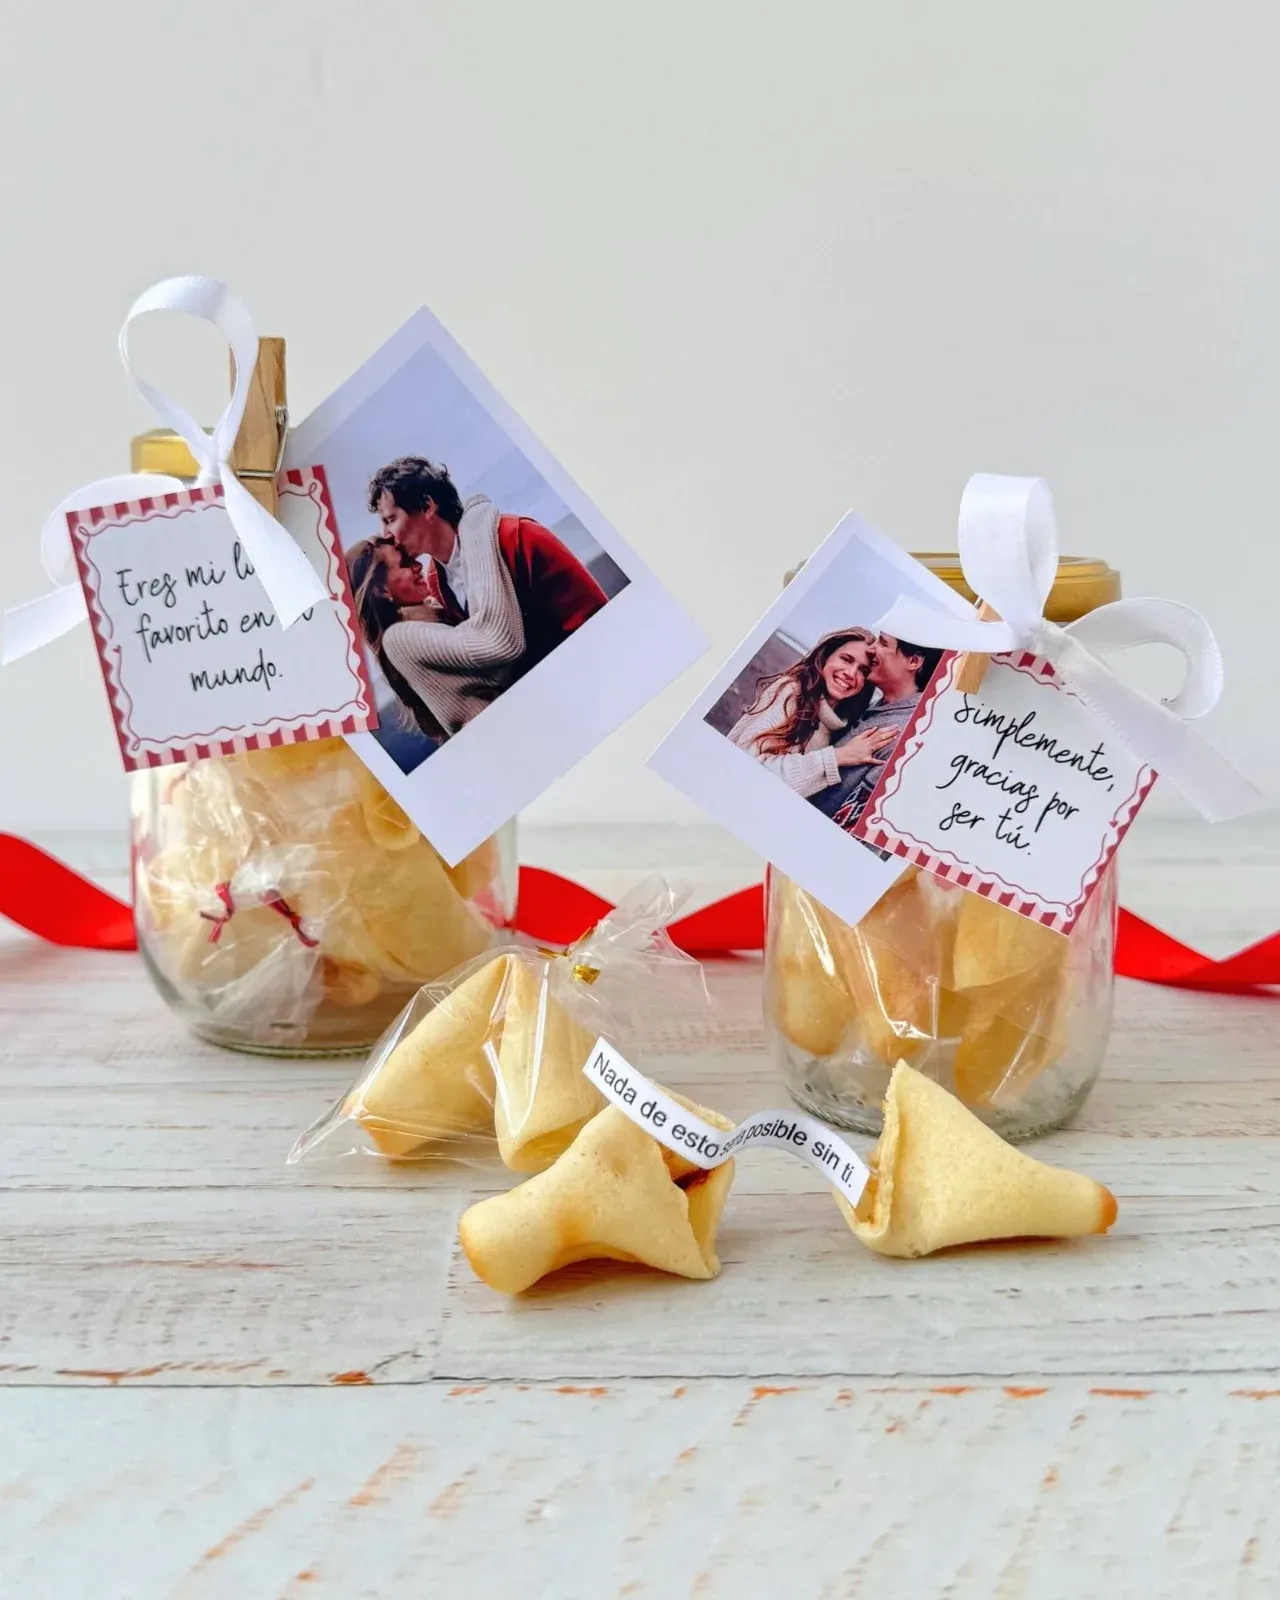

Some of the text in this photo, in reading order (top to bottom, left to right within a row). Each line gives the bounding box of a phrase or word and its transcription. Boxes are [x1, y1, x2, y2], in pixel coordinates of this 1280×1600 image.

[115, 568, 177, 608] Eres
[185, 560, 226, 587] mi
[136, 600, 275, 663] favorito en
[190, 648, 283, 691] mundo.
[936, 754, 1080, 833] gracias por
[939, 802, 1032, 856] ser tú.
[592, 1051, 638, 1105] Nada
[640, 1097, 667, 1128] de
[671, 1123, 720, 1158] esto
[743, 1119, 808, 1146] posible
[811, 1140, 841, 1171] sin
[841, 1162, 856, 1188] ti.
